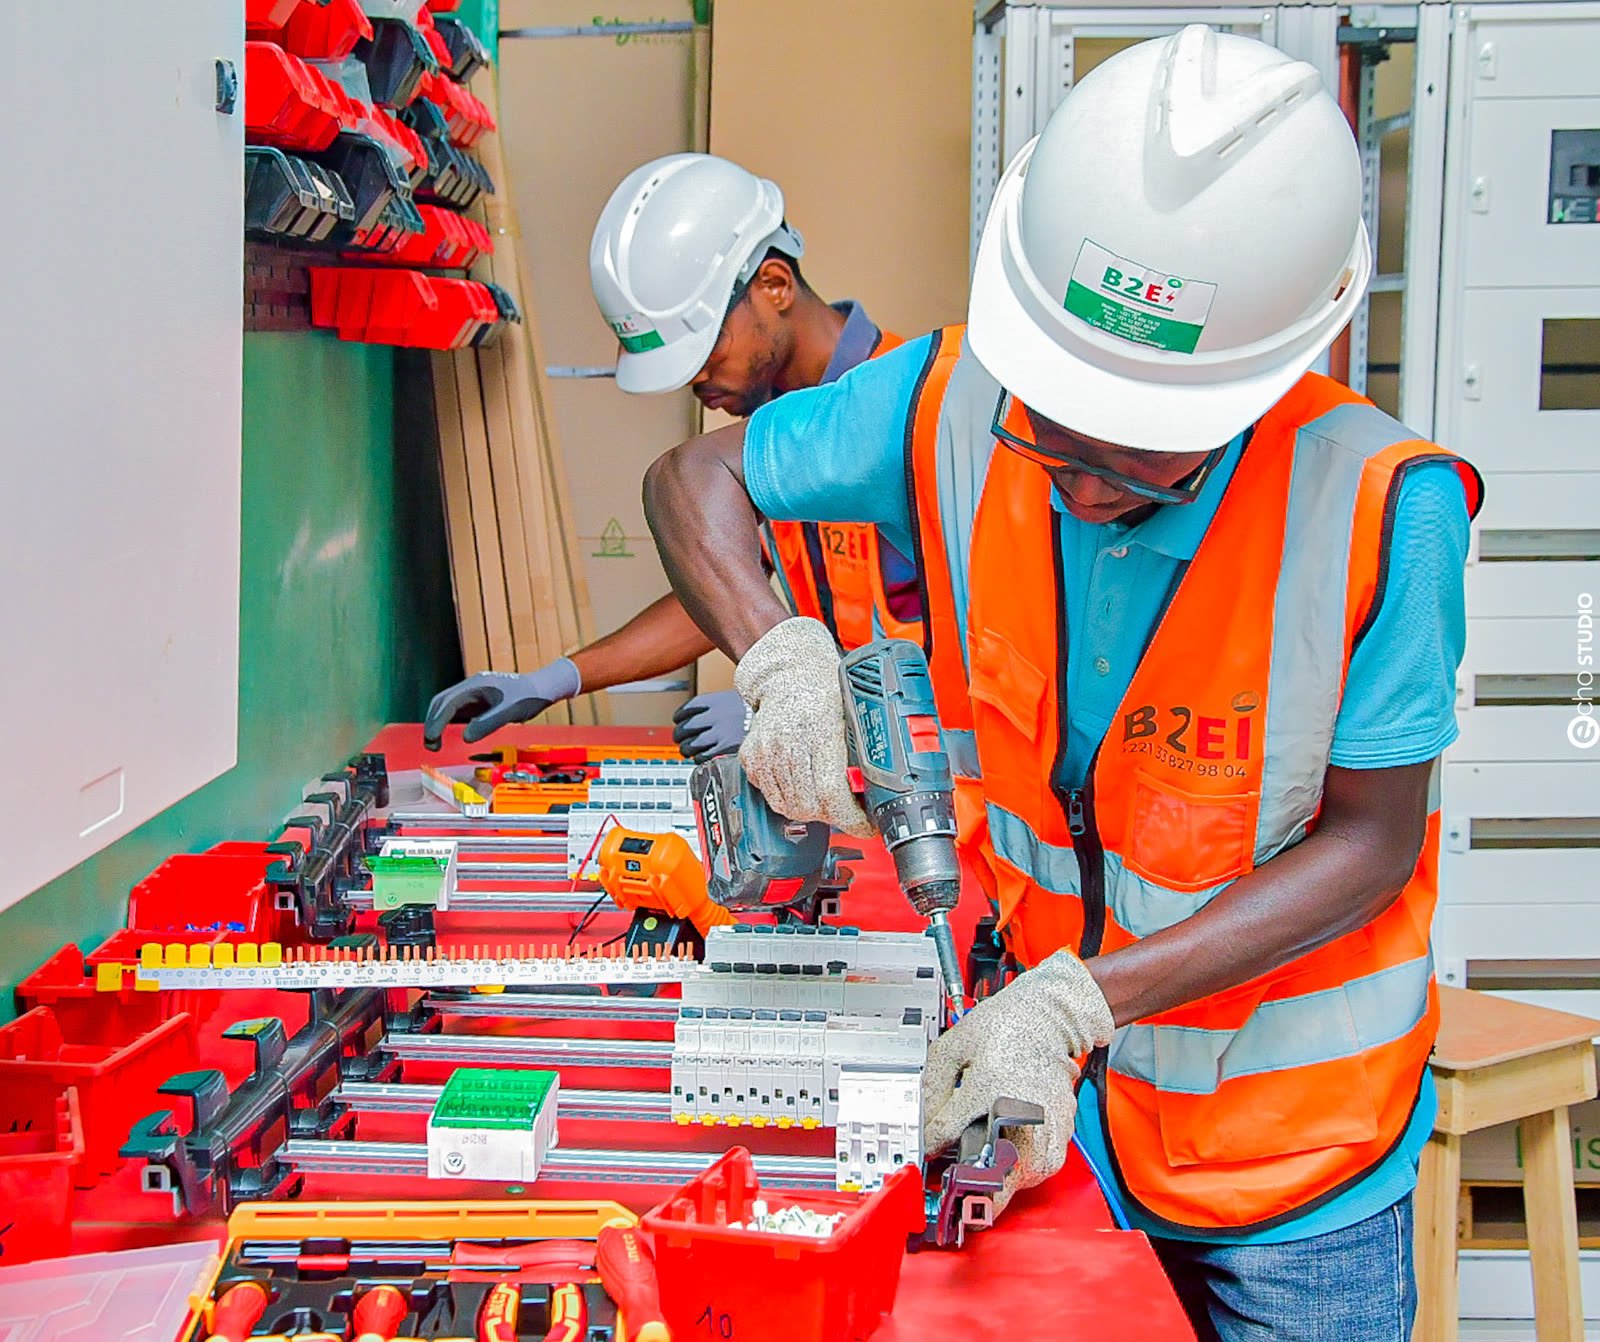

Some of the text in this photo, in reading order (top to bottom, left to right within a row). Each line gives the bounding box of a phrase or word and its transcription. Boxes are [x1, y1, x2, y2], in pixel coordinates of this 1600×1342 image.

[1155, 745, 1168, 763] 33
[1169, 754, 1194, 772] 827
[1197, 764, 1218, 777] 98
[1223, 764, 1246, 778] 04
[706, 793, 718, 824] 18V
[696, 1305, 732, 1340] 10
